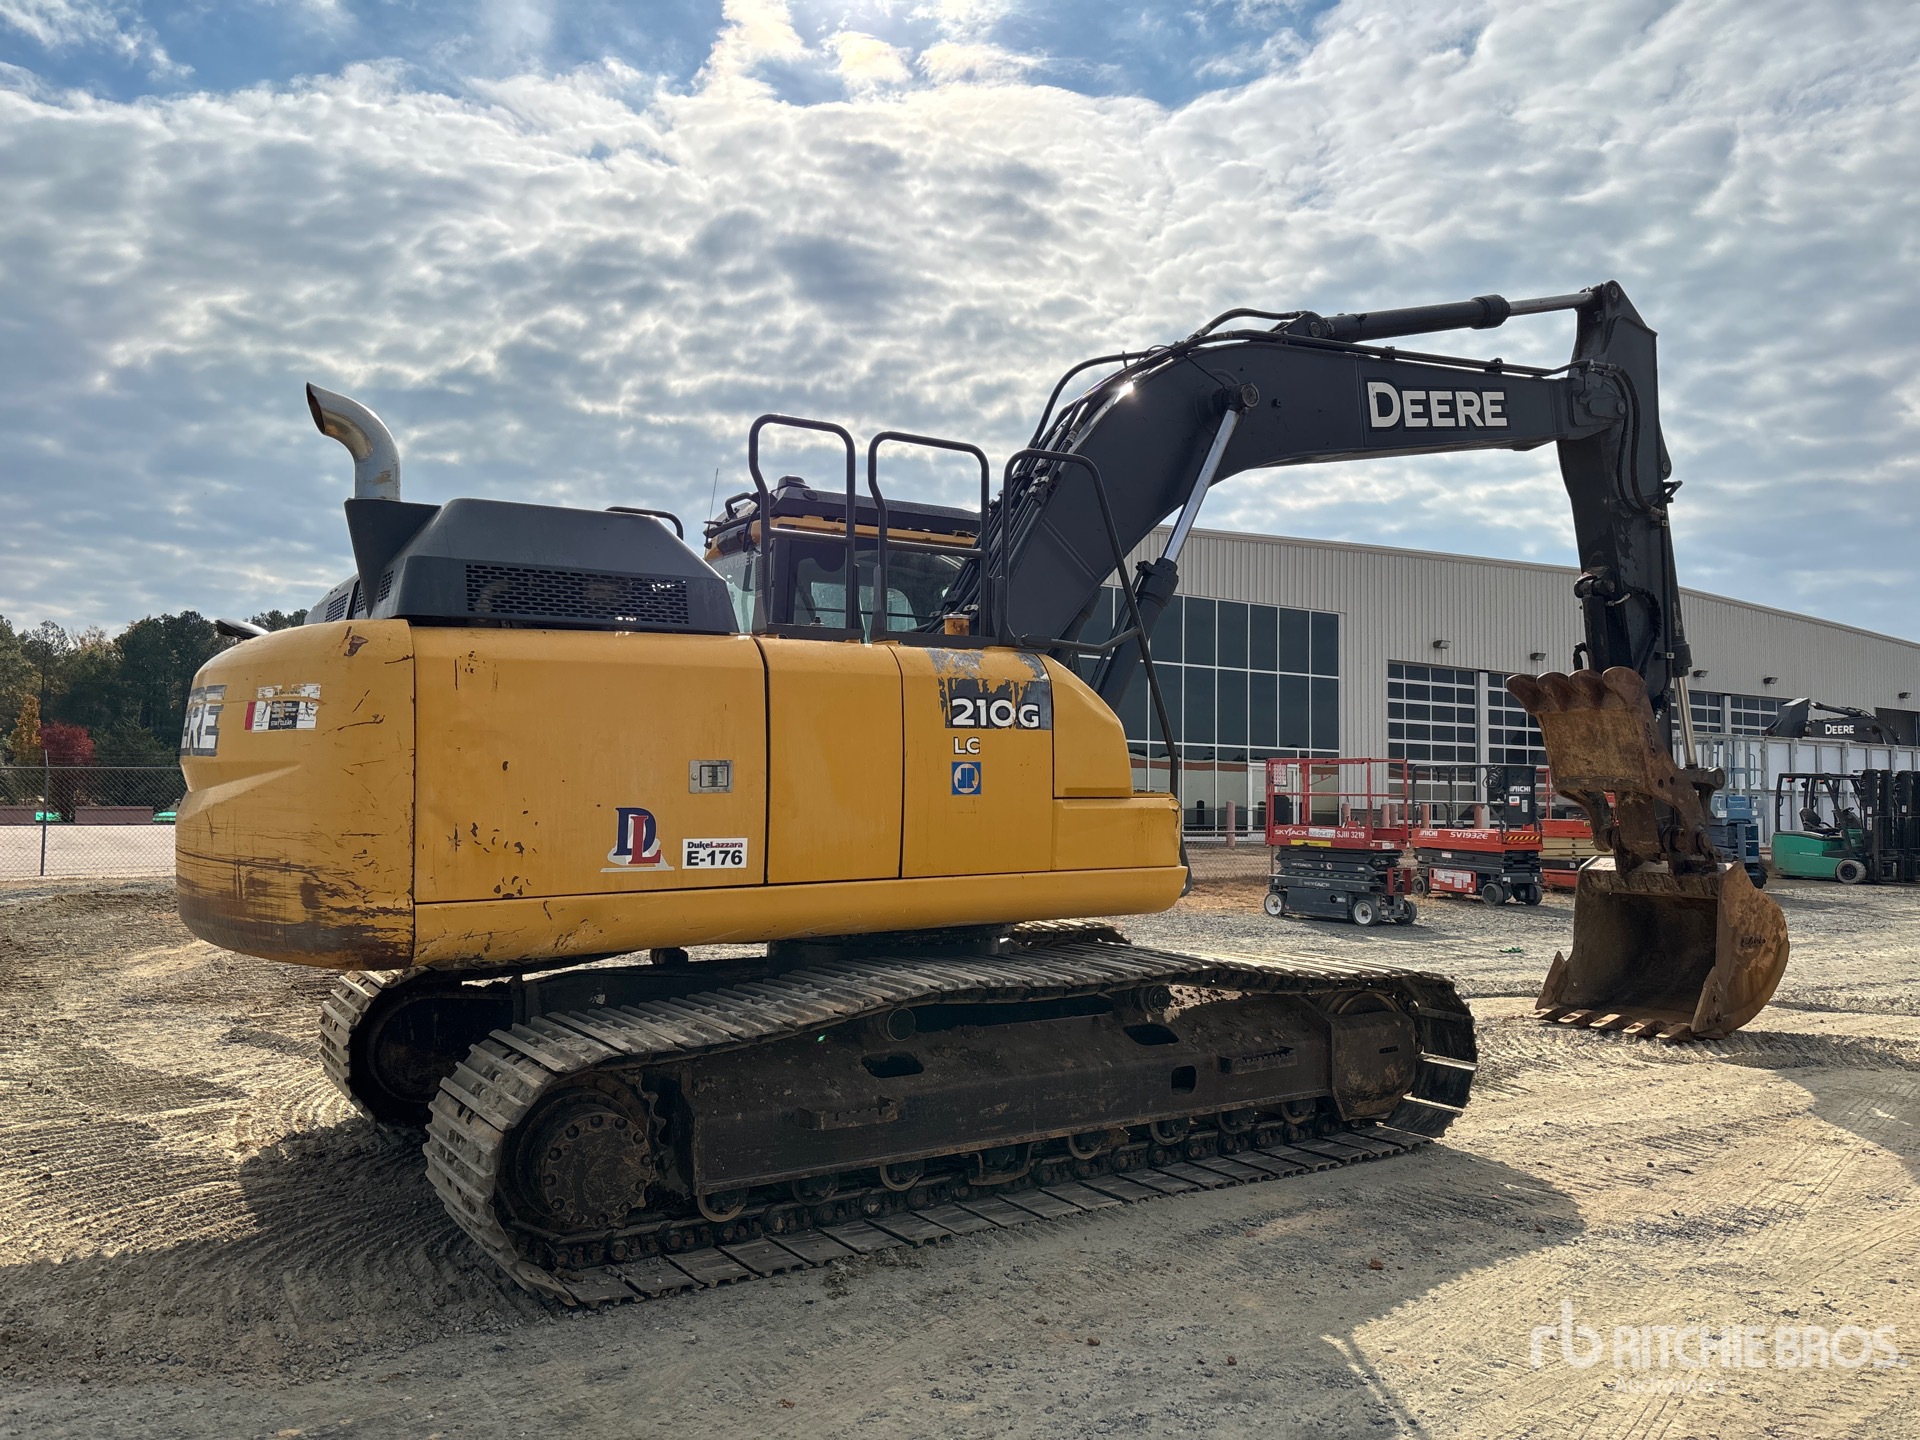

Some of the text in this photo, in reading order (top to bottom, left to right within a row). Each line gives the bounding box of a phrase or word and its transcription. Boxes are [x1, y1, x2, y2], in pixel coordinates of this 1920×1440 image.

[1367, 382, 1508, 428] DEERE
[952, 698, 1039, 728] 210G
[1825, 724, 1854, 734] DEERE
[954, 738, 980, 754] LC
[613, 807, 661, 864] DL
[1274, 828, 1307, 836] SKYJACK
[687, 841, 743, 850] DukeLazzara
[687, 850, 742, 866] E-176
